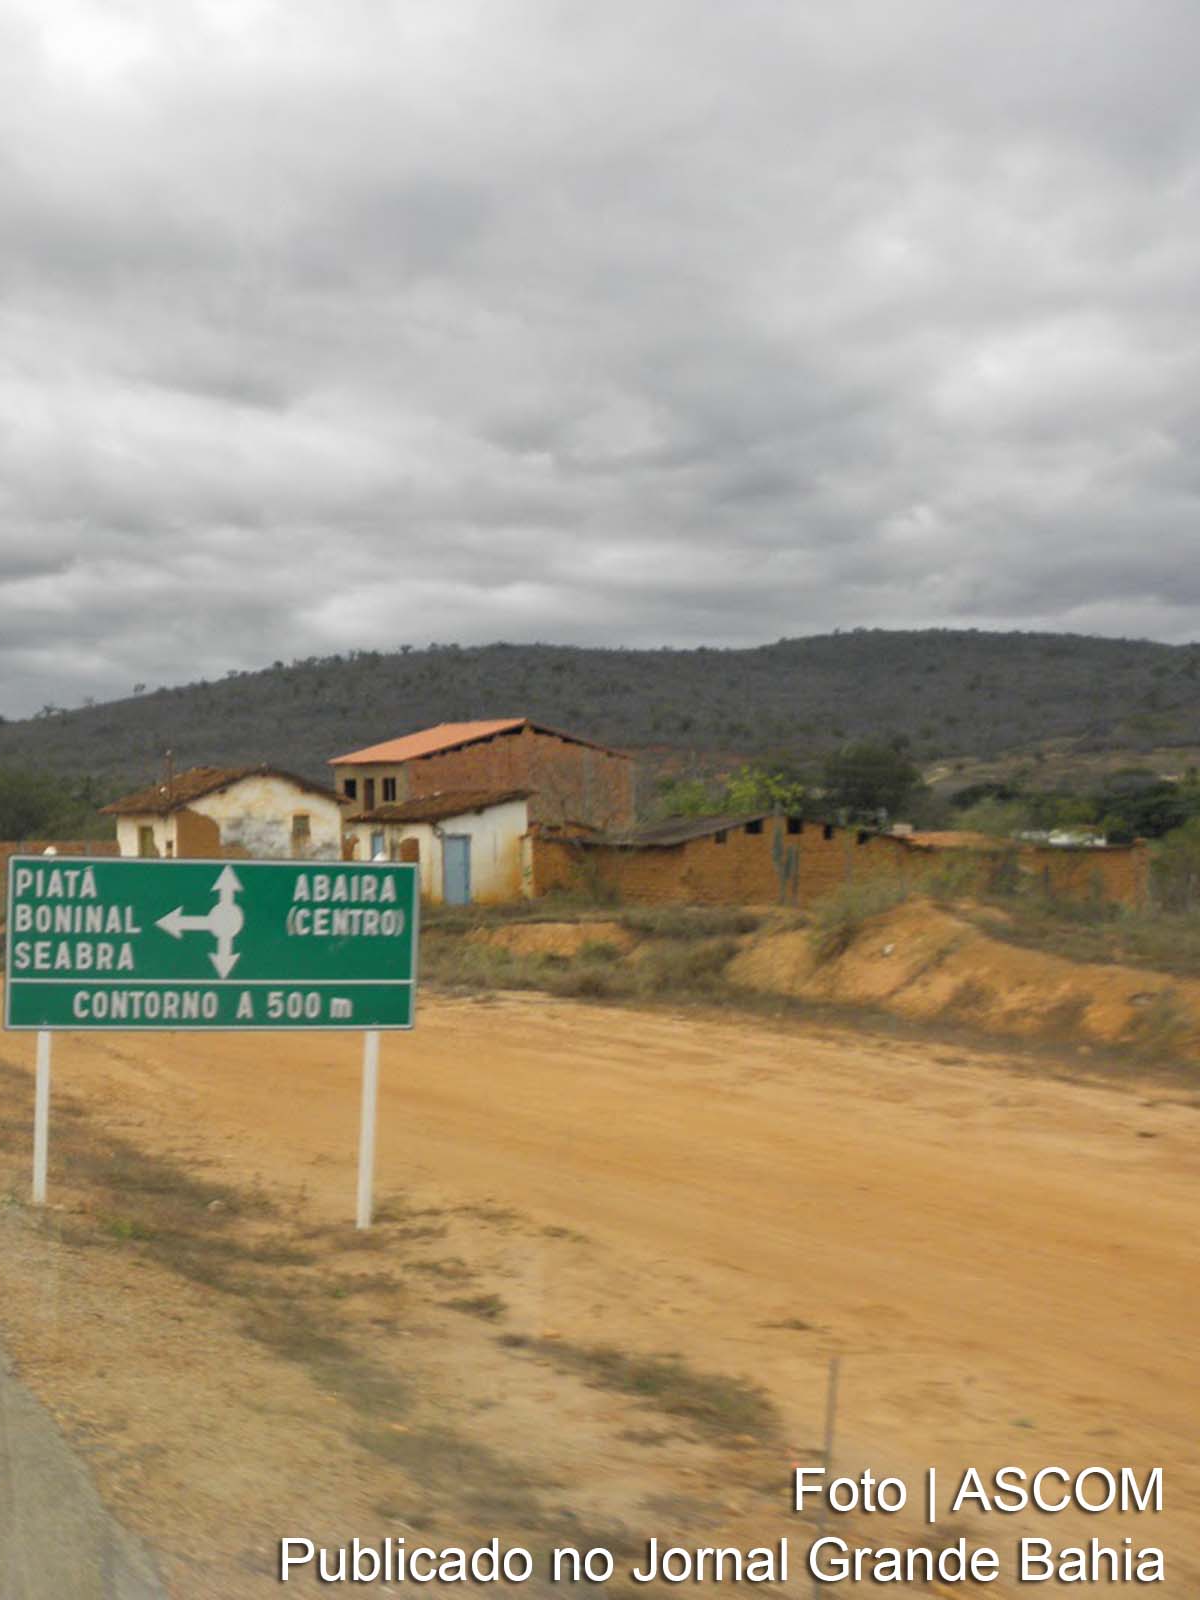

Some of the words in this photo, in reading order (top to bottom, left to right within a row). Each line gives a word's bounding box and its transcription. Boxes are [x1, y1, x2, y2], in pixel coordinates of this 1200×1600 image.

[15, 865, 98, 898] PIATÁ
[293, 873, 397, 902] ABAIRA
[15, 903, 142, 934] BONINAL
[286, 906, 405, 937] (CENTRO)
[14, 941, 135, 970] SEABRA
[72, 991, 218, 1019] CONTORNO
[236, 991, 254, 1018] A
[267, 991, 321, 1019] 500
[330, 997, 353, 1018] m
